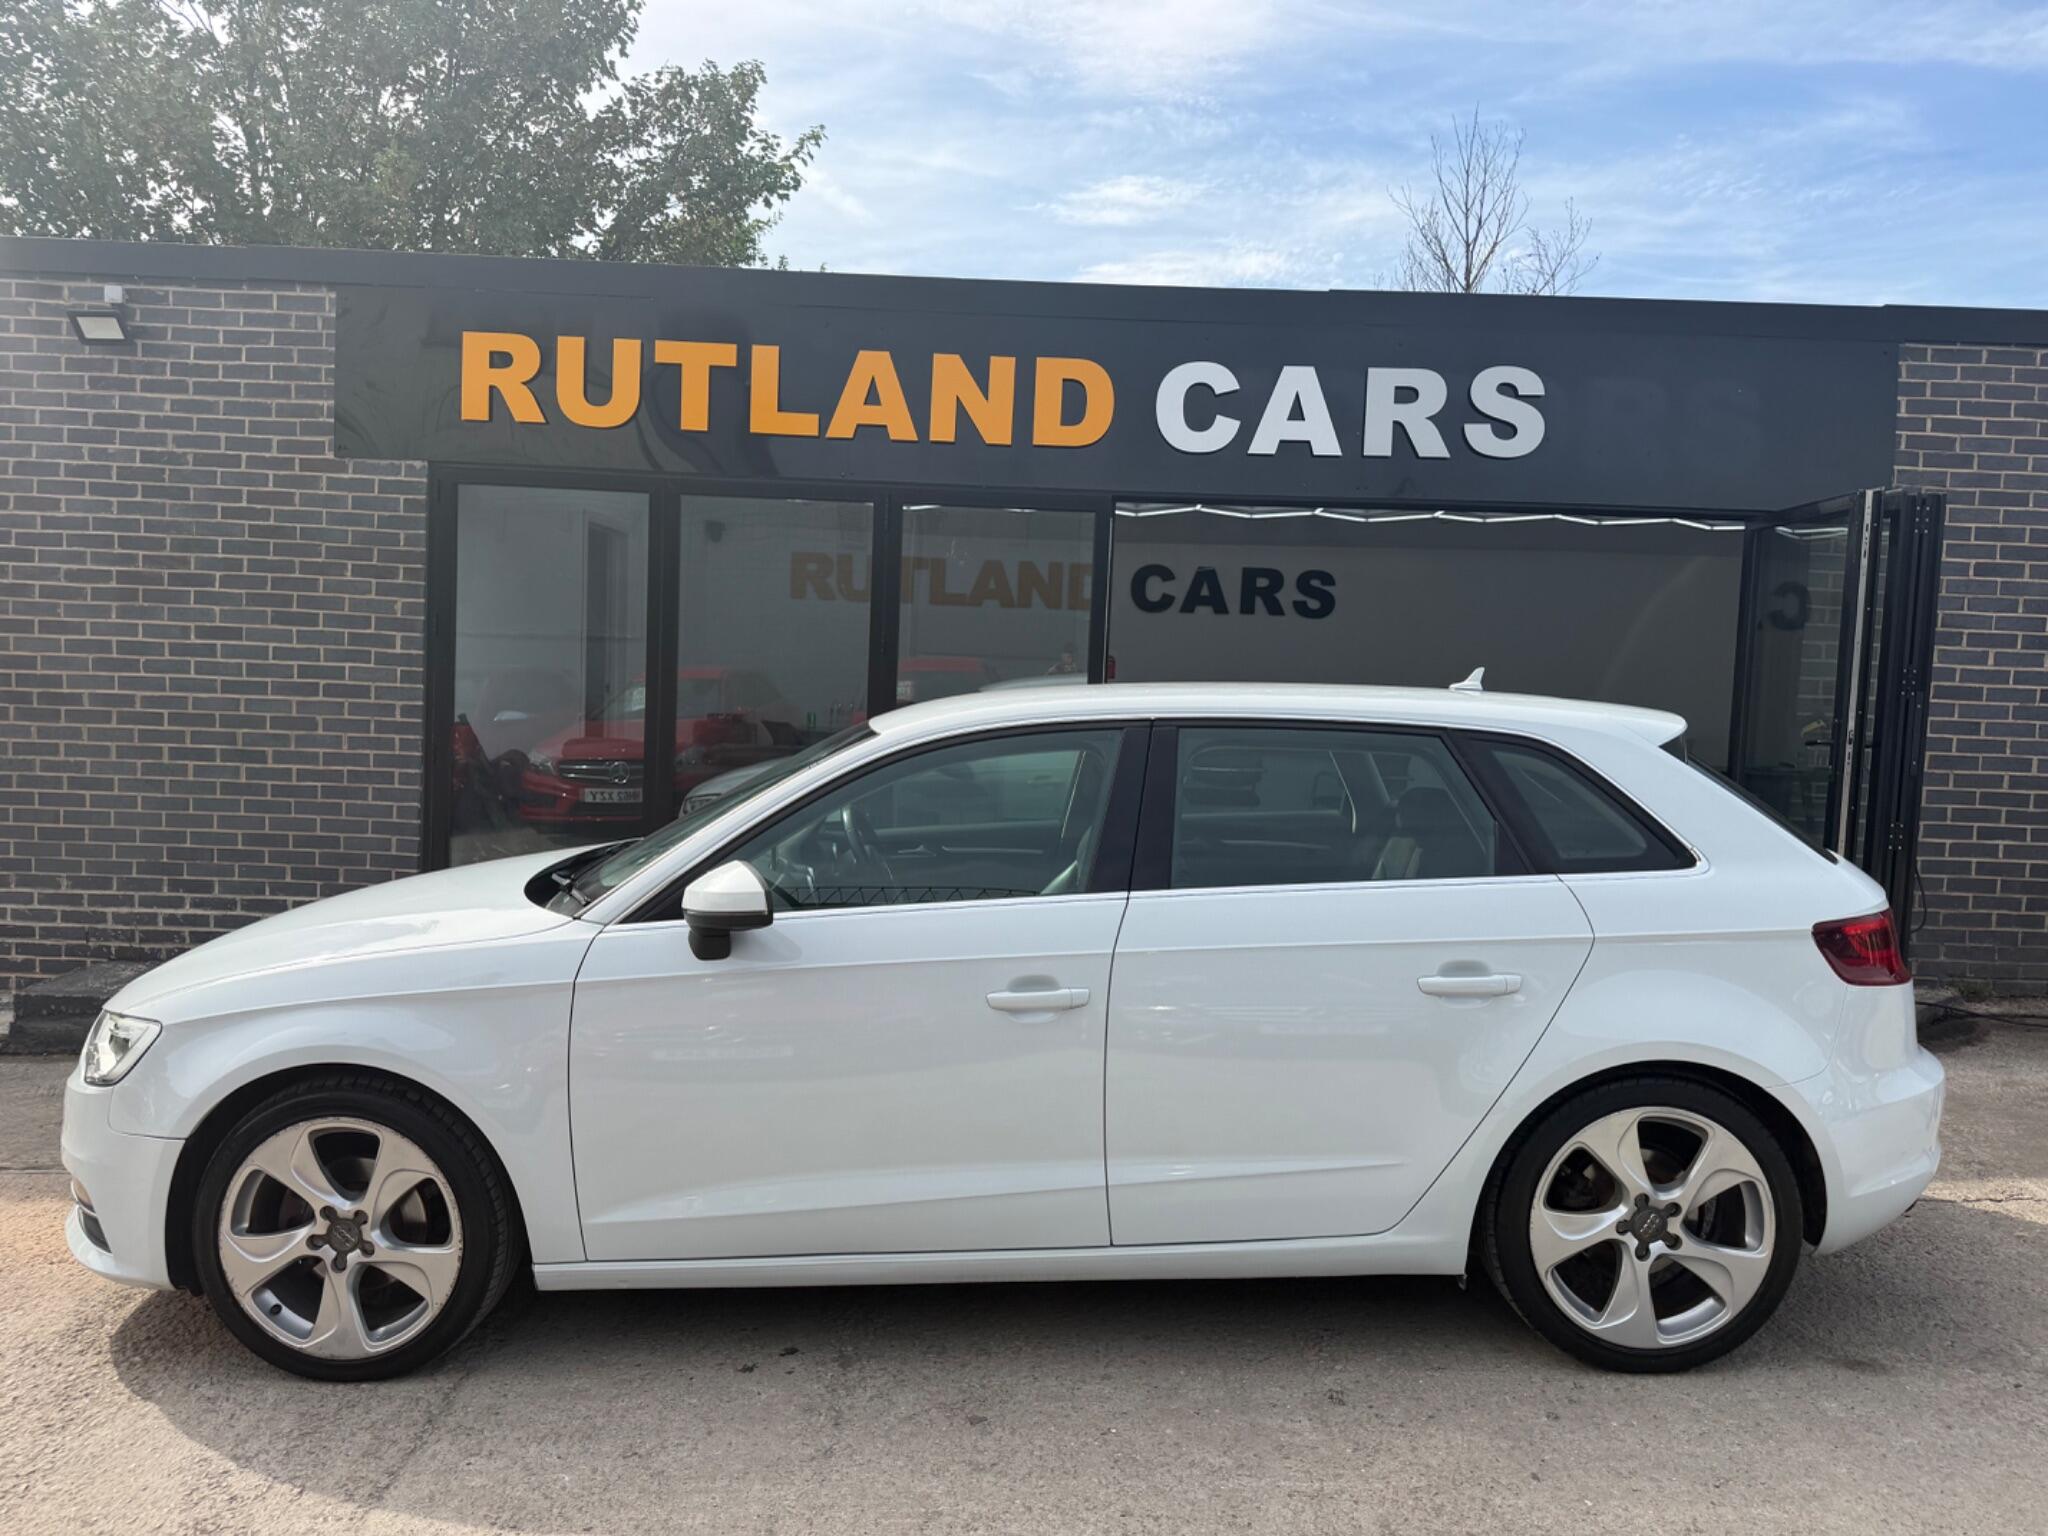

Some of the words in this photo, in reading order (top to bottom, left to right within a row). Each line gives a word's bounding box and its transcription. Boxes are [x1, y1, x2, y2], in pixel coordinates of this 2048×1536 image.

[461, 331, 1115, 447] RUTLAND
[1156, 361, 1546, 459] CARS
[1130, 564, 1337, 620] CARS
